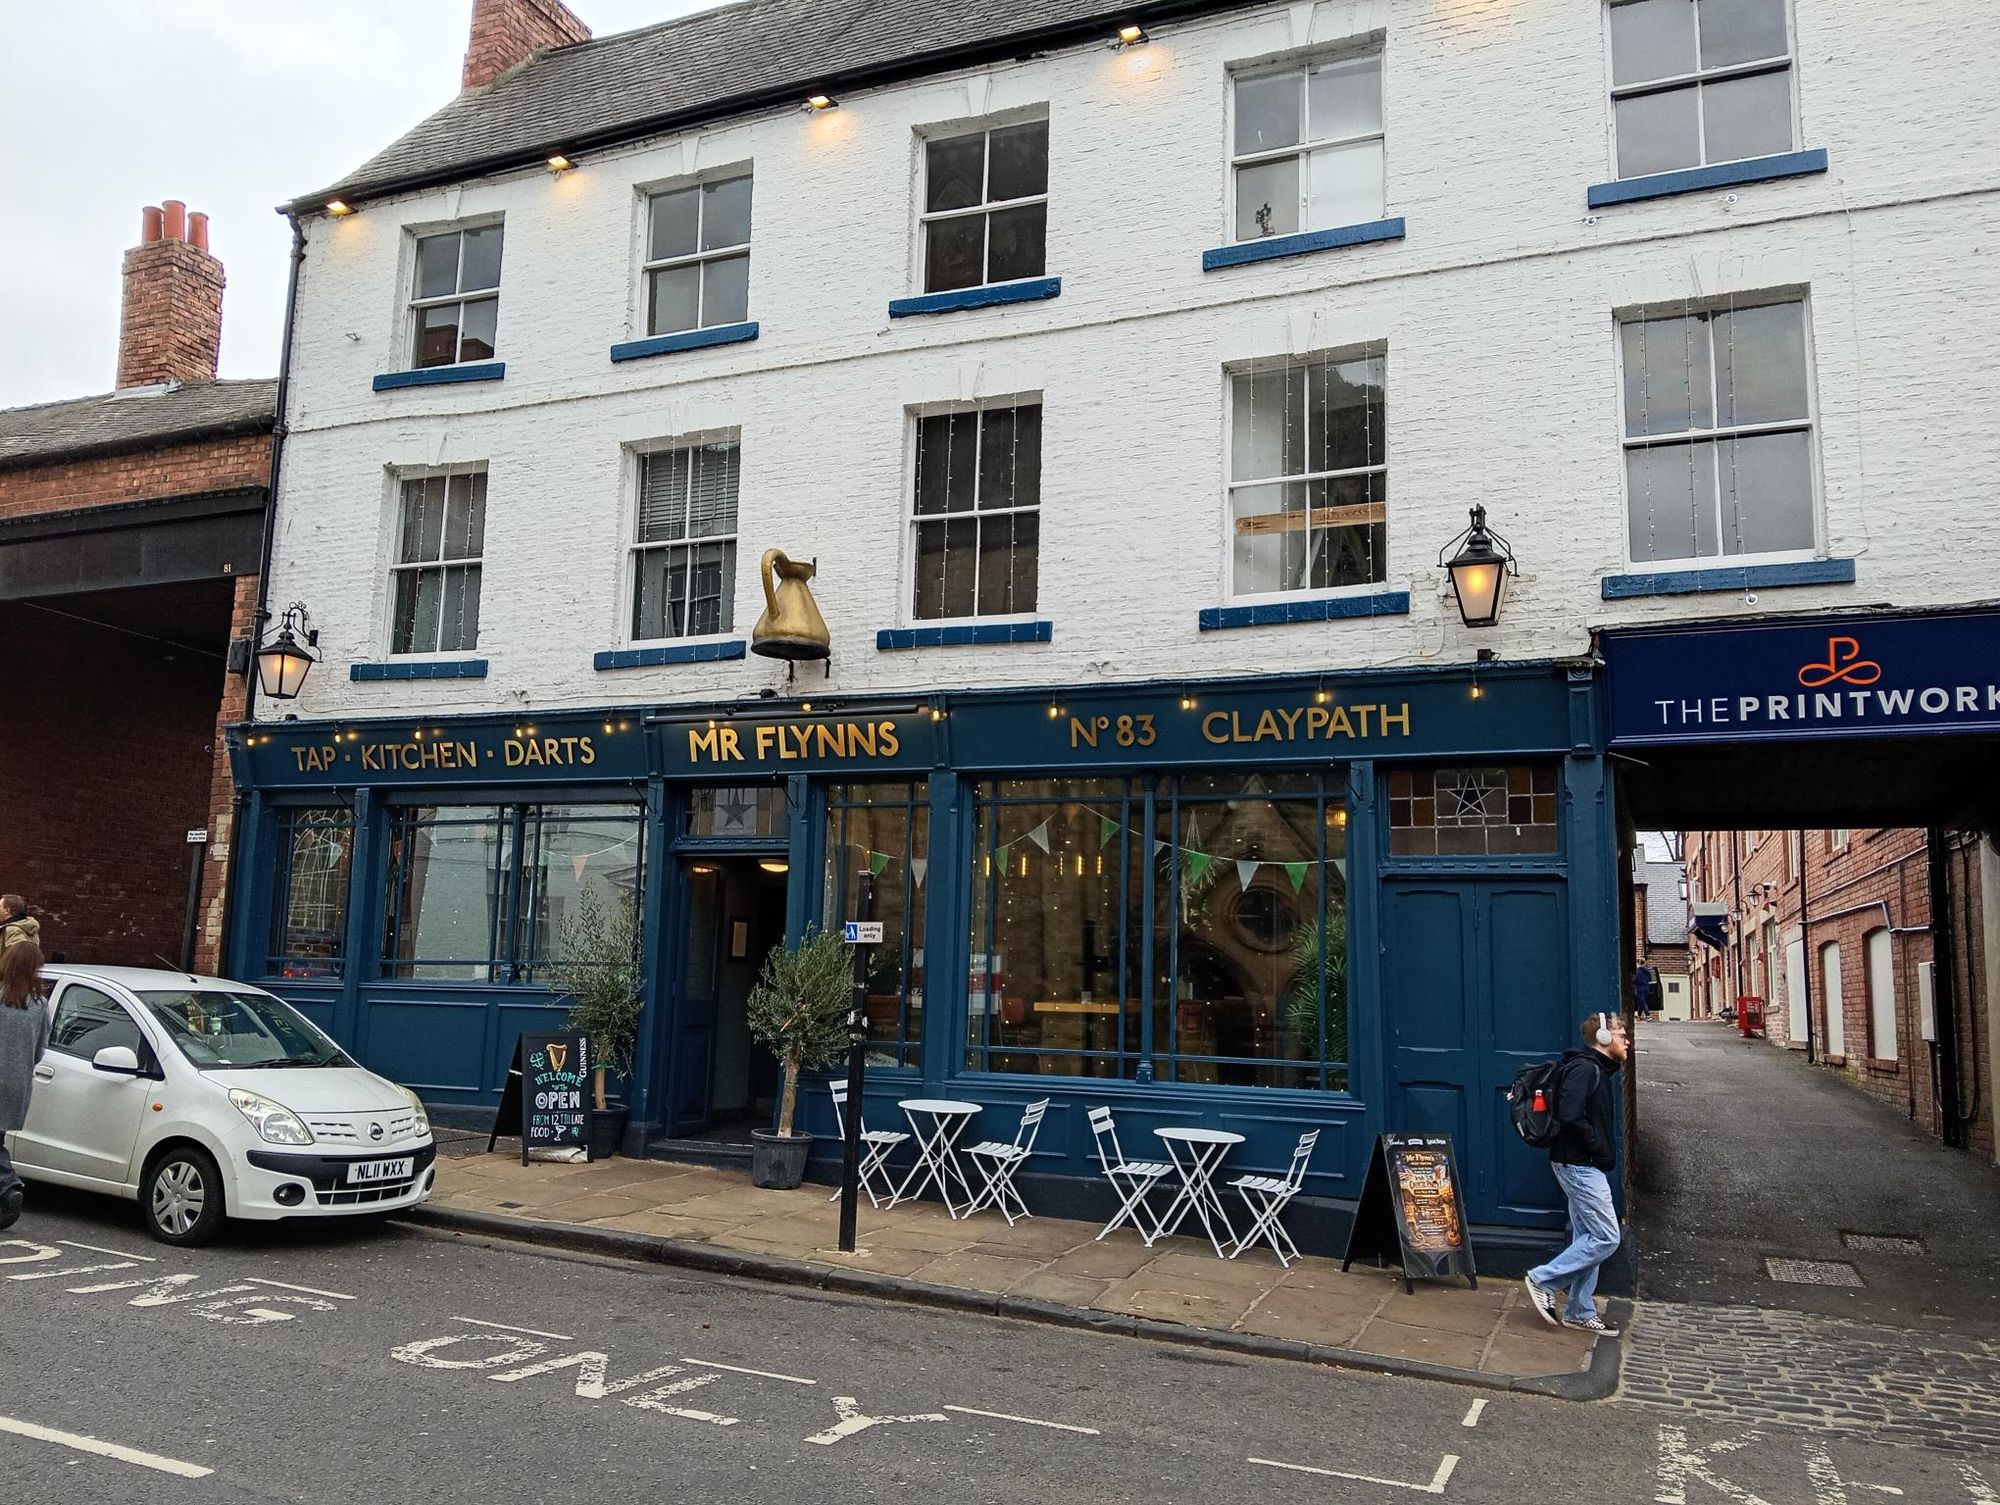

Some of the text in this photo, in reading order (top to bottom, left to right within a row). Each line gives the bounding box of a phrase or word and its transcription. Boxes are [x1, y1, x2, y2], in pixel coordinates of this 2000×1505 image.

[223, 563, 232, 573] 81
[1654, 698, 1730, 725] THE
[1202, 703, 1411, 744] CLAYPATH
[688, 721, 900, 763] MR FLYNNS
[291, 736, 597, 772] TAP KITCHEN DARTS
[859, 925, 882, 933] Loading
[579, 1037, 587, 1079] GUINNESS
[535, 1071, 584, 1087] WELCOME
[535, 1091, 580, 1110] OPEN
[532, 1114, 550, 1126] FROM
[551, 1114, 560, 1126] 12
[571, 1113, 584, 1125] LATE
[530, 1126, 550, 1138] FOOD
[357, 1160, 405, 1180] NL11 WXX
[390, 1333, 950, 1446] ONLY
